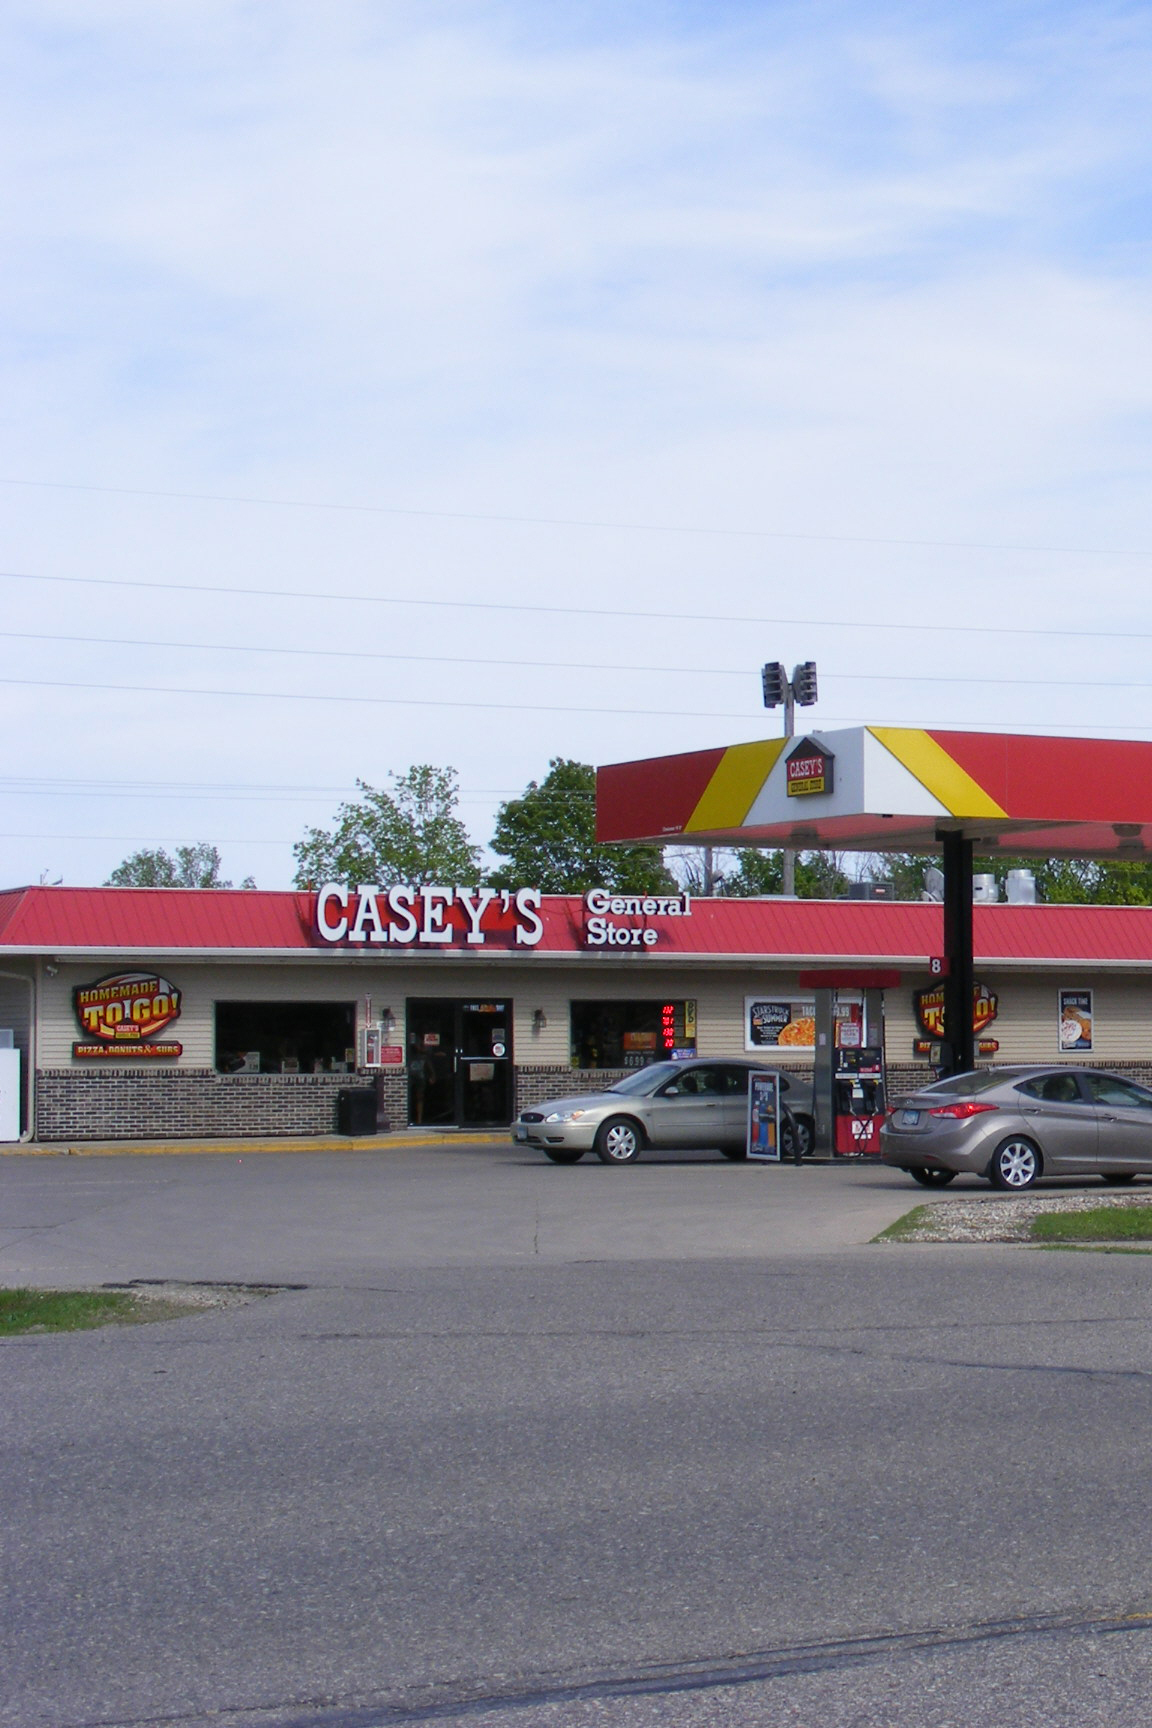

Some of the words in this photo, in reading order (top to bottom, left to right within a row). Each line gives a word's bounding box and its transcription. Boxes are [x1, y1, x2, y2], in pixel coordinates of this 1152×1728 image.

[790, 758, 823, 777] CASEY'S
[316, 882, 544, 945] CASEY'S
[586, 888, 692, 917] General
[586, 917, 658, 945] Store
[931, 958, 941, 974] 8
[80, 981, 158, 1003] HOMEMADE
[762, 1013, 788, 1024] SUMMER
